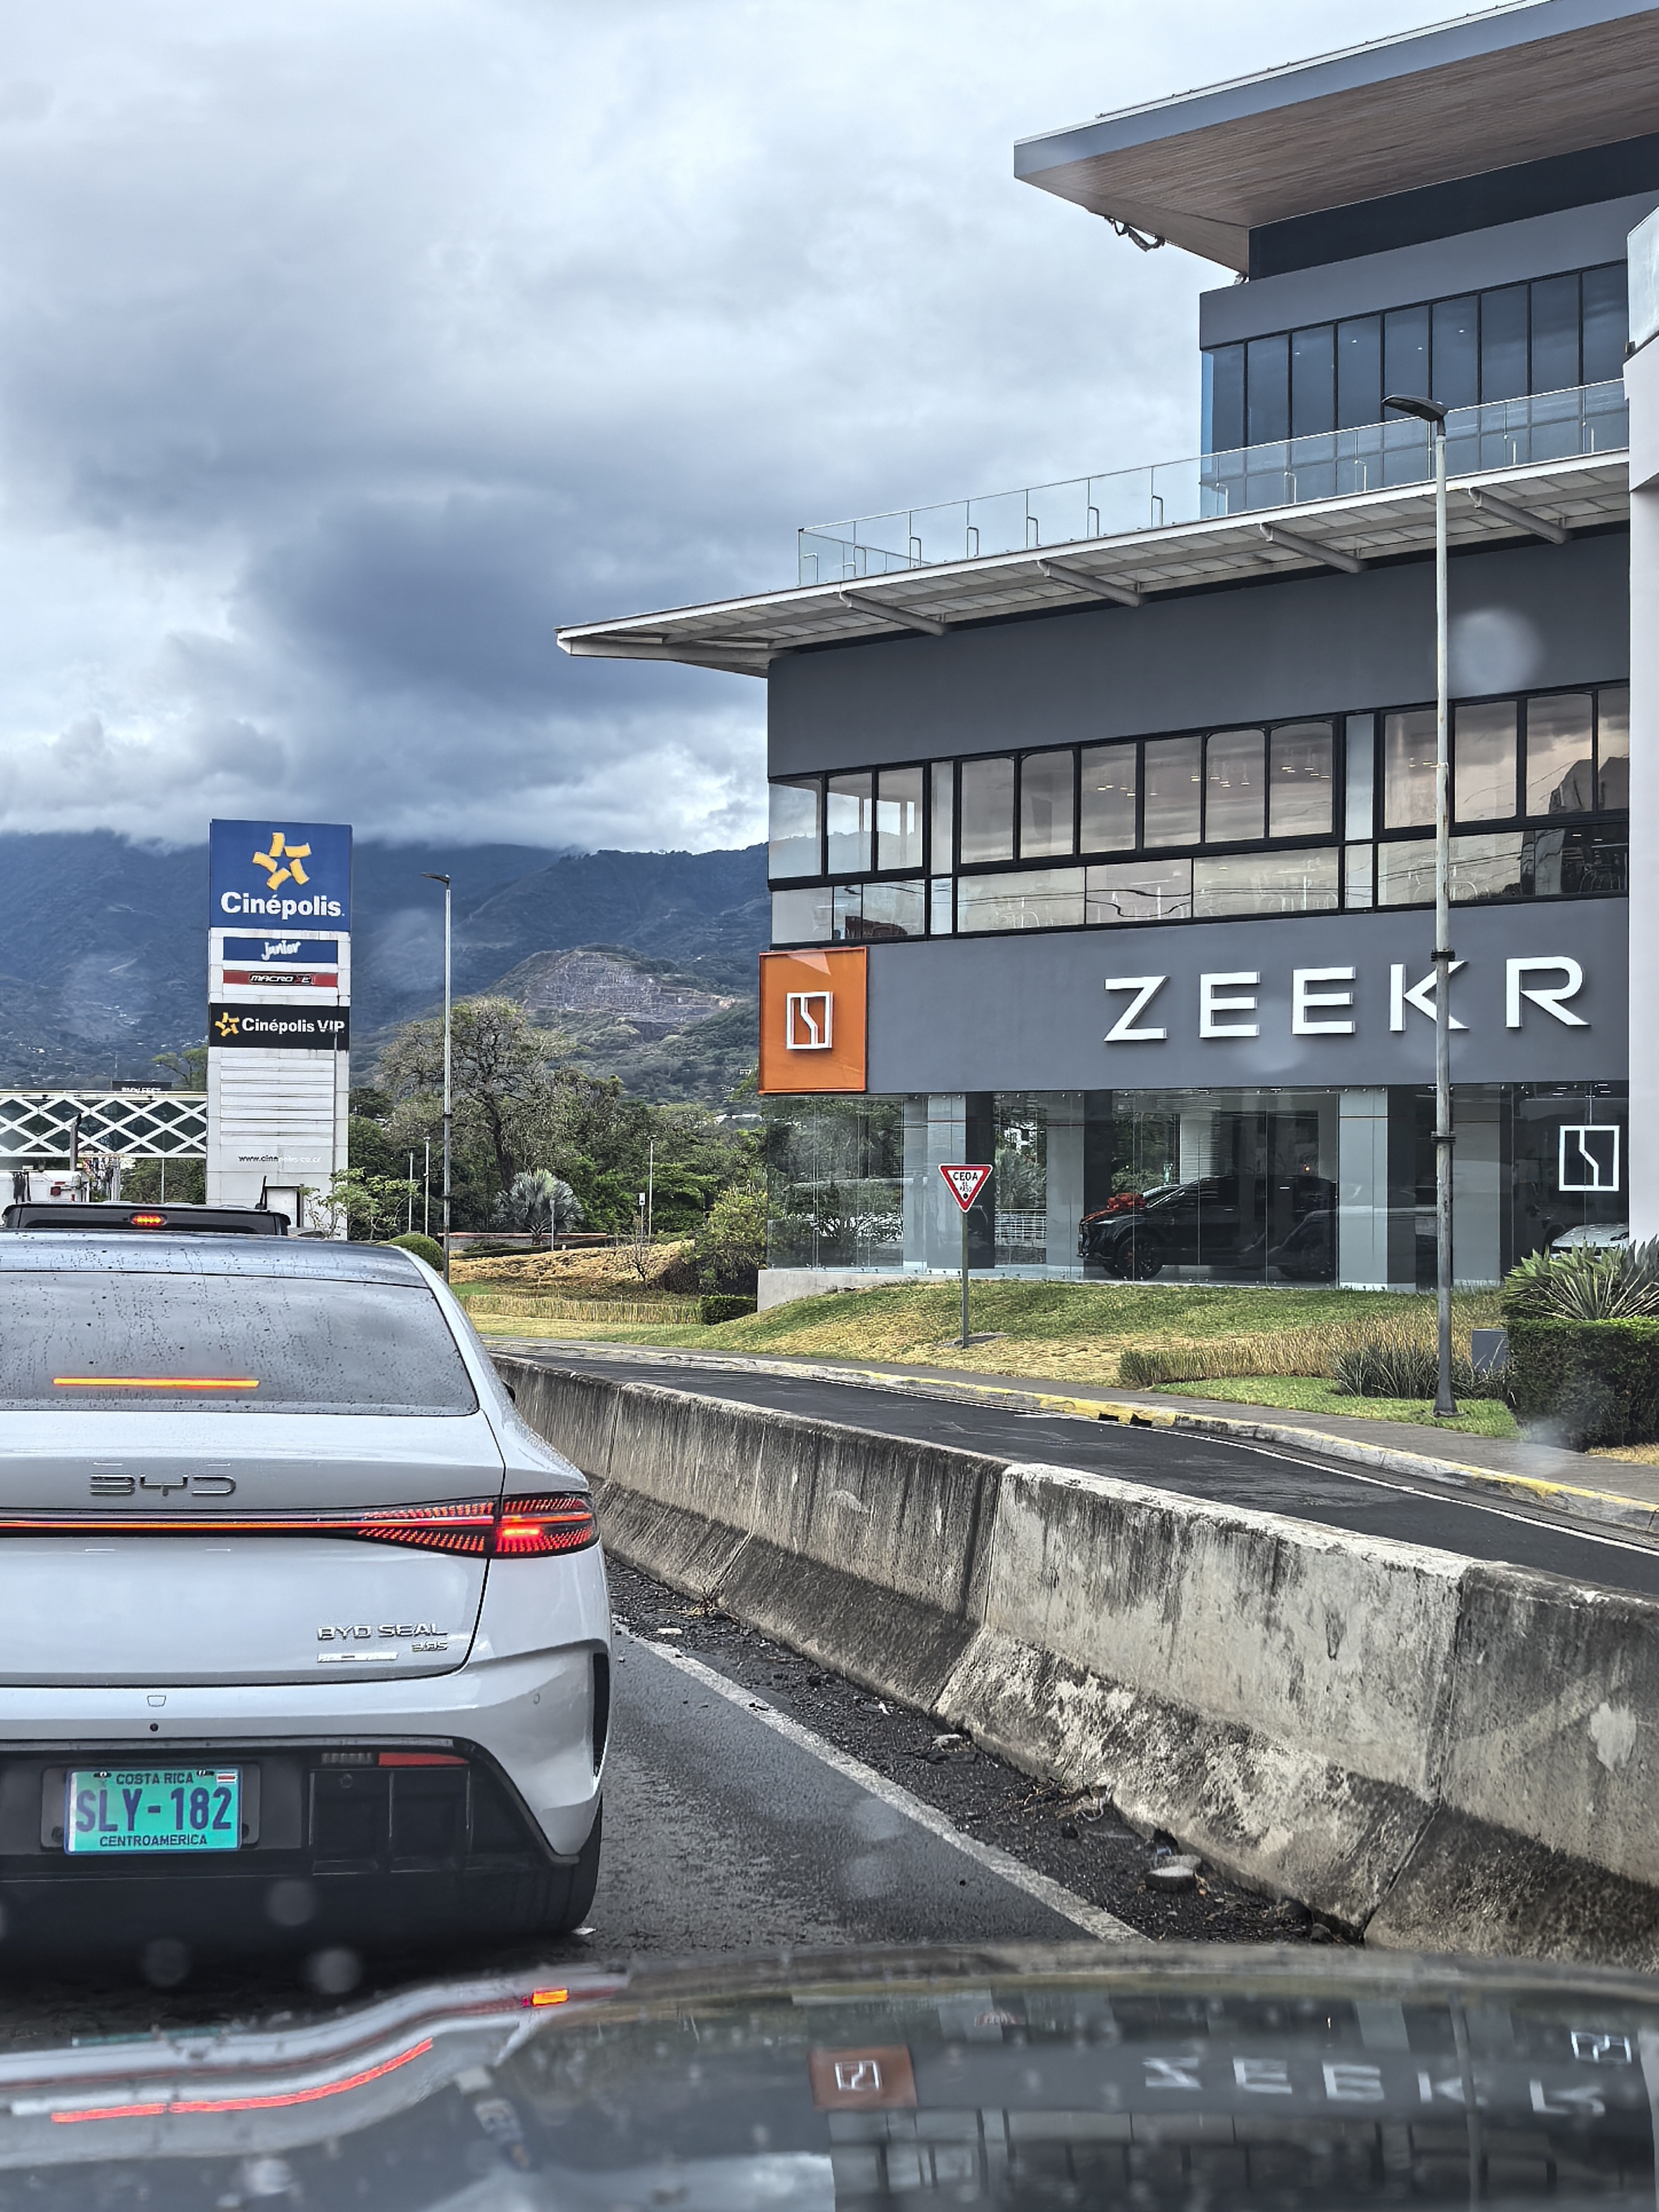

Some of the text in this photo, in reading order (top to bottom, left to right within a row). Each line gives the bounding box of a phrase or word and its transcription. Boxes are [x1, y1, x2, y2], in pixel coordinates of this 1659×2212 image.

[221, 892, 342, 920] Cinépolis
[1104, 956, 1591, 1042] ZEEKR
[242, 1017, 345, 1034] Cinépolis VIP
[953, 1172, 978, 1181] CEDA
[90, 1474, 237, 1496] BYD
[318, 1622, 448, 1640] BYD SEAL
[116, 1772, 194, 1785] COSTA RICA
[76, 1787, 232, 1832] SLY-182
[100, 1834, 207, 1847] CENTROAMERICA
